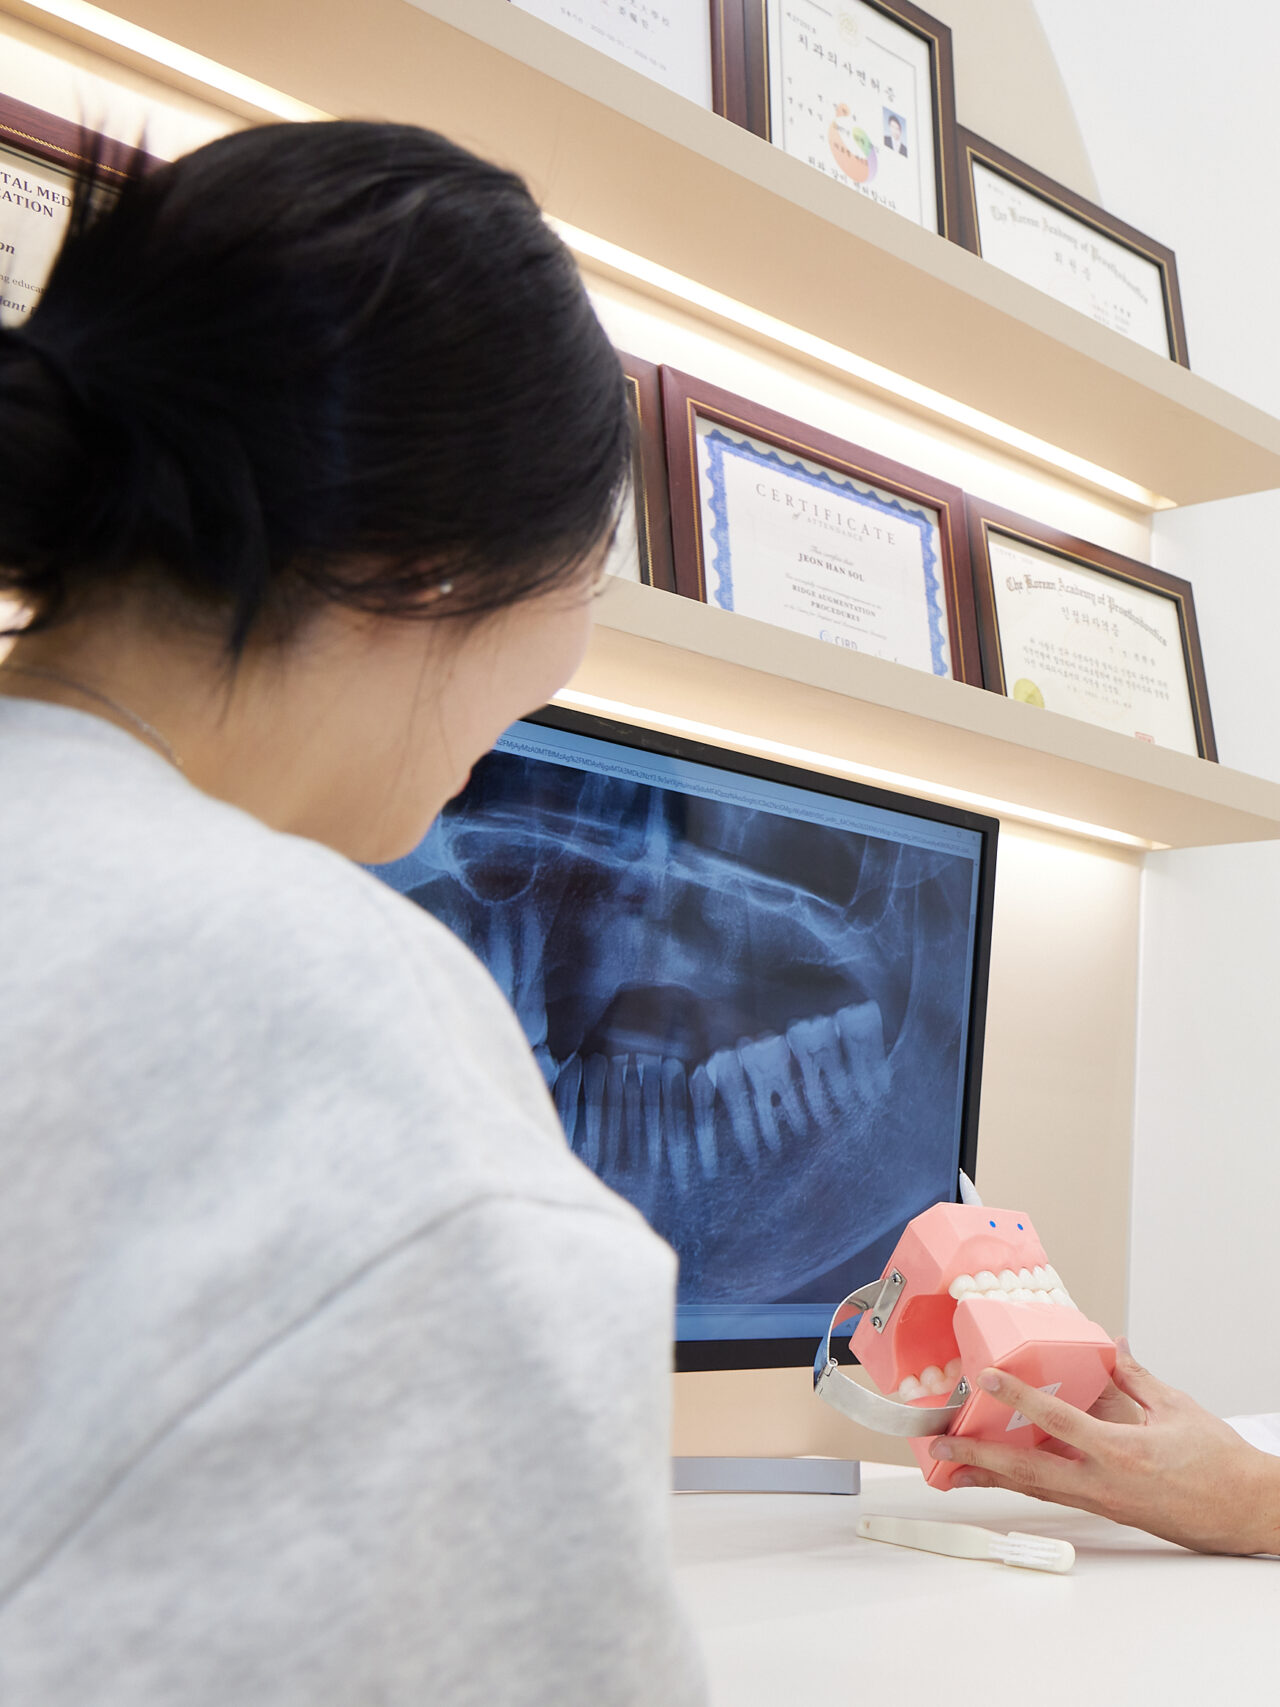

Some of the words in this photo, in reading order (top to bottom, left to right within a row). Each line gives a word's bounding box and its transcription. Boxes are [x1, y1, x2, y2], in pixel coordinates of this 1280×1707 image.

[0, 188, 54, 218] ATION
[755, 483, 896, 546] CERTIFICATE
[798, 552, 824, 568] JEON
[825, 561, 846, 576] HAN
[848, 569, 865, 583] SOL
[818, 591, 877, 618] AUGMENTATION
[1023, 574, 1057, 595] Korean
[1058, 577, 1097, 607] Academy
[810, 600, 861, 623] PROCEDURES
